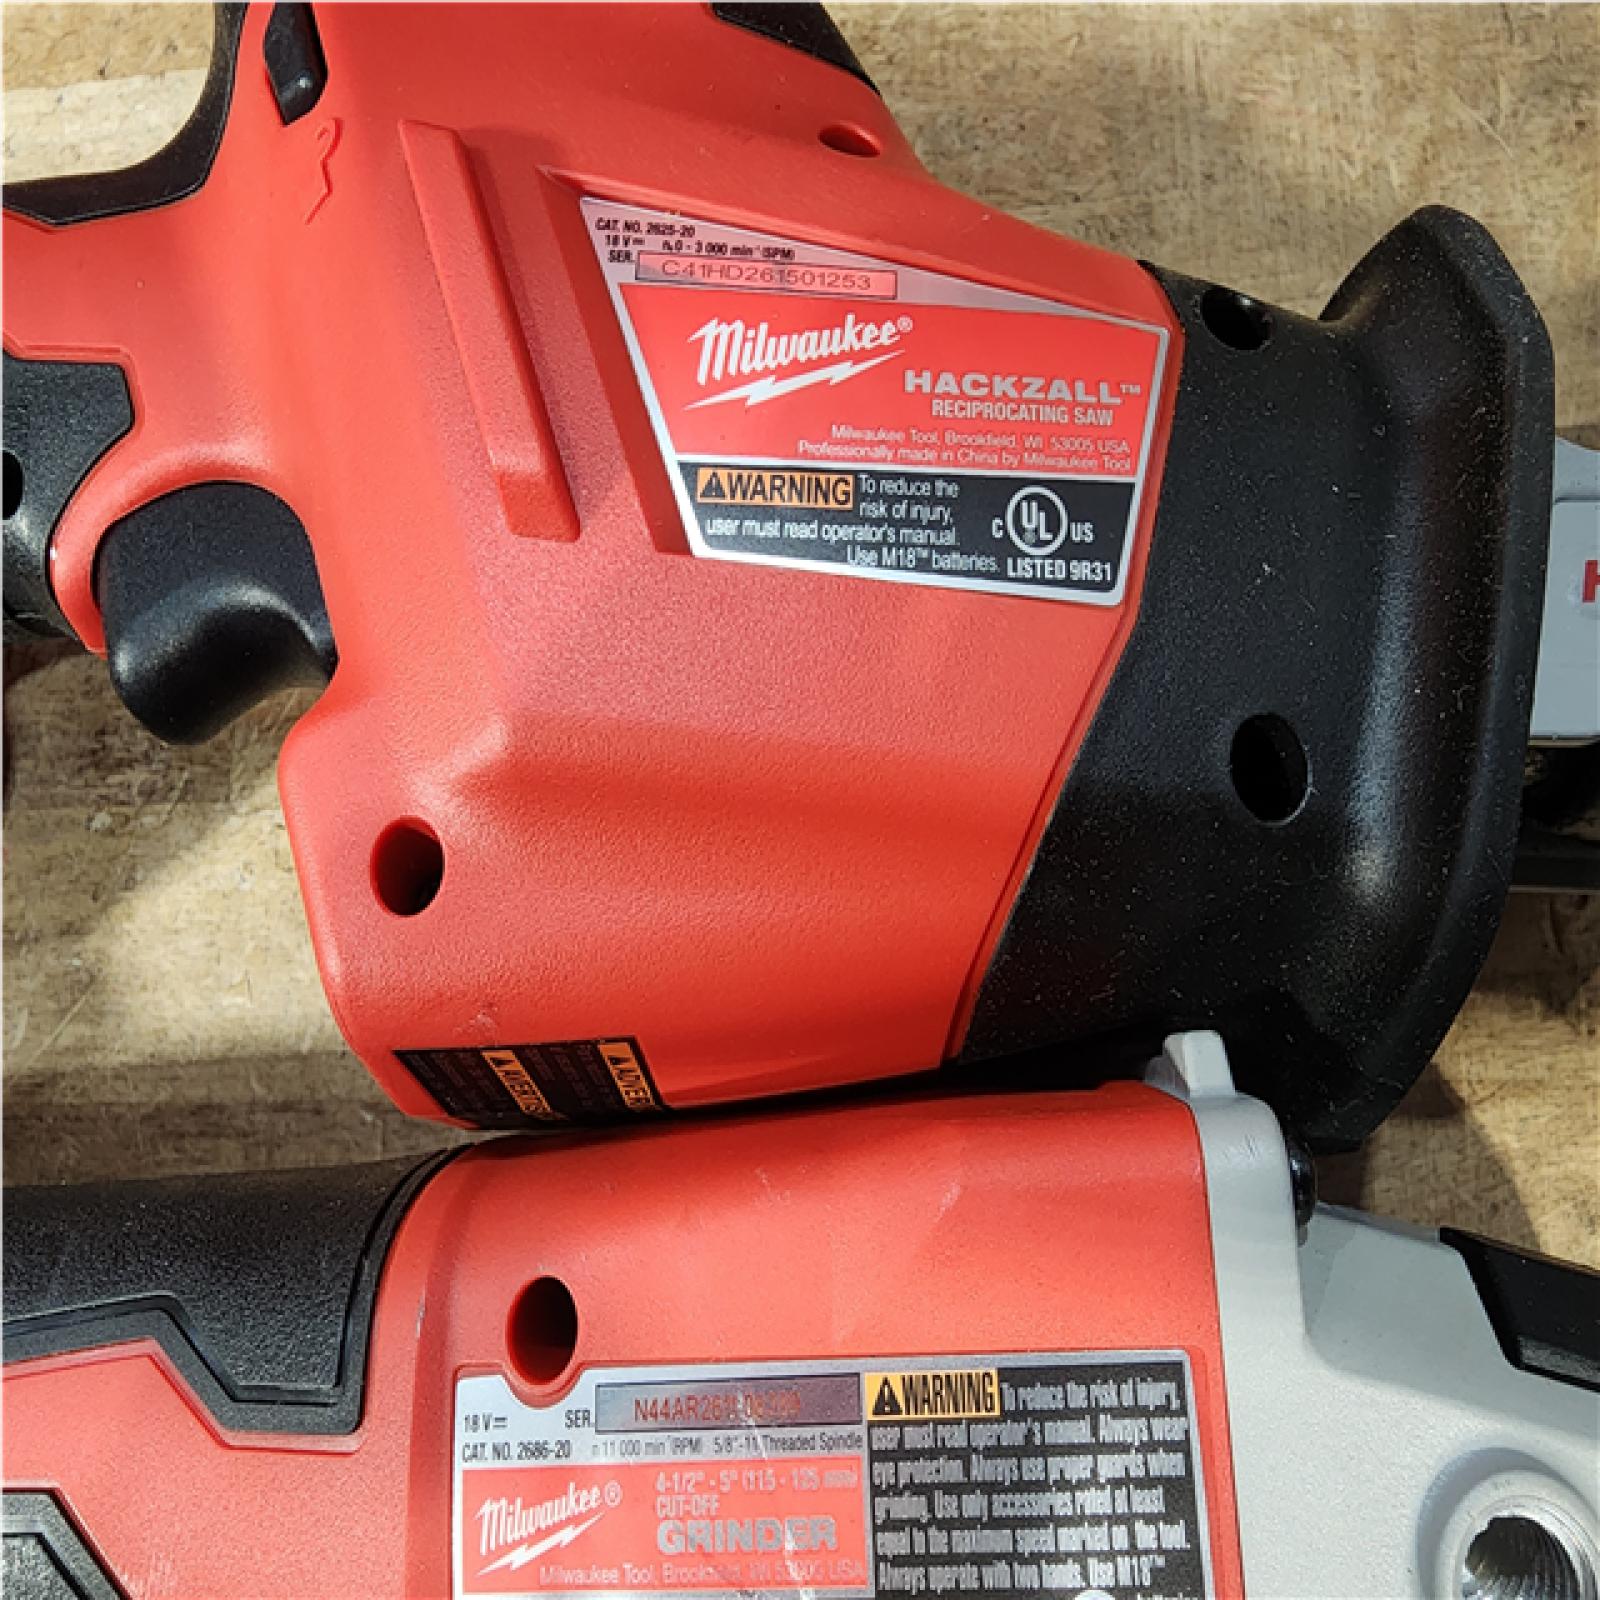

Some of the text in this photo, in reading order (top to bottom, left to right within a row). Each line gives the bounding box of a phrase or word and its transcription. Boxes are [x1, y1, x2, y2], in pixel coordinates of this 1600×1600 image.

[662, 259, 871, 291] C41HD261501253
[931, 399, 1113, 426] RECIPROCATING SAW
[831, 425, 904, 443] Milwaukee
[1098, 441, 1131, 454] USA
[799, 438, 1131, 471] Professionally made in China by Milwaukee Tool
[727, 472, 851, 505] WARNING
[858, 473, 960, 499] To reduce the
[859, 501, 954, 526] risk of injury,
[706, 519, 741, 536] user
[743, 519, 780, 538] must
[784, 520, 818, 539] read
[822, 522, 896, 545] operator's
[1071, 523, 1093, 543] US
[847, 544, 878, 567] Use
[932, 550, 998, 573] batteries.
[1007, 557, 1112, 583] LISTED 9R31
[902, 1371, 994, 1416] WARNING
[517, 1439, 571, 1461] 2686-20
[761, 1432, 817, 1453] Threaded
[819, 1430, 863, 1452] Spindle
[656, 1495, 719, 1518] CUT-OFF
[657, 1516, 838, 1555] GRINDER
[539, 1561, 619, 1586] Milwaukee
